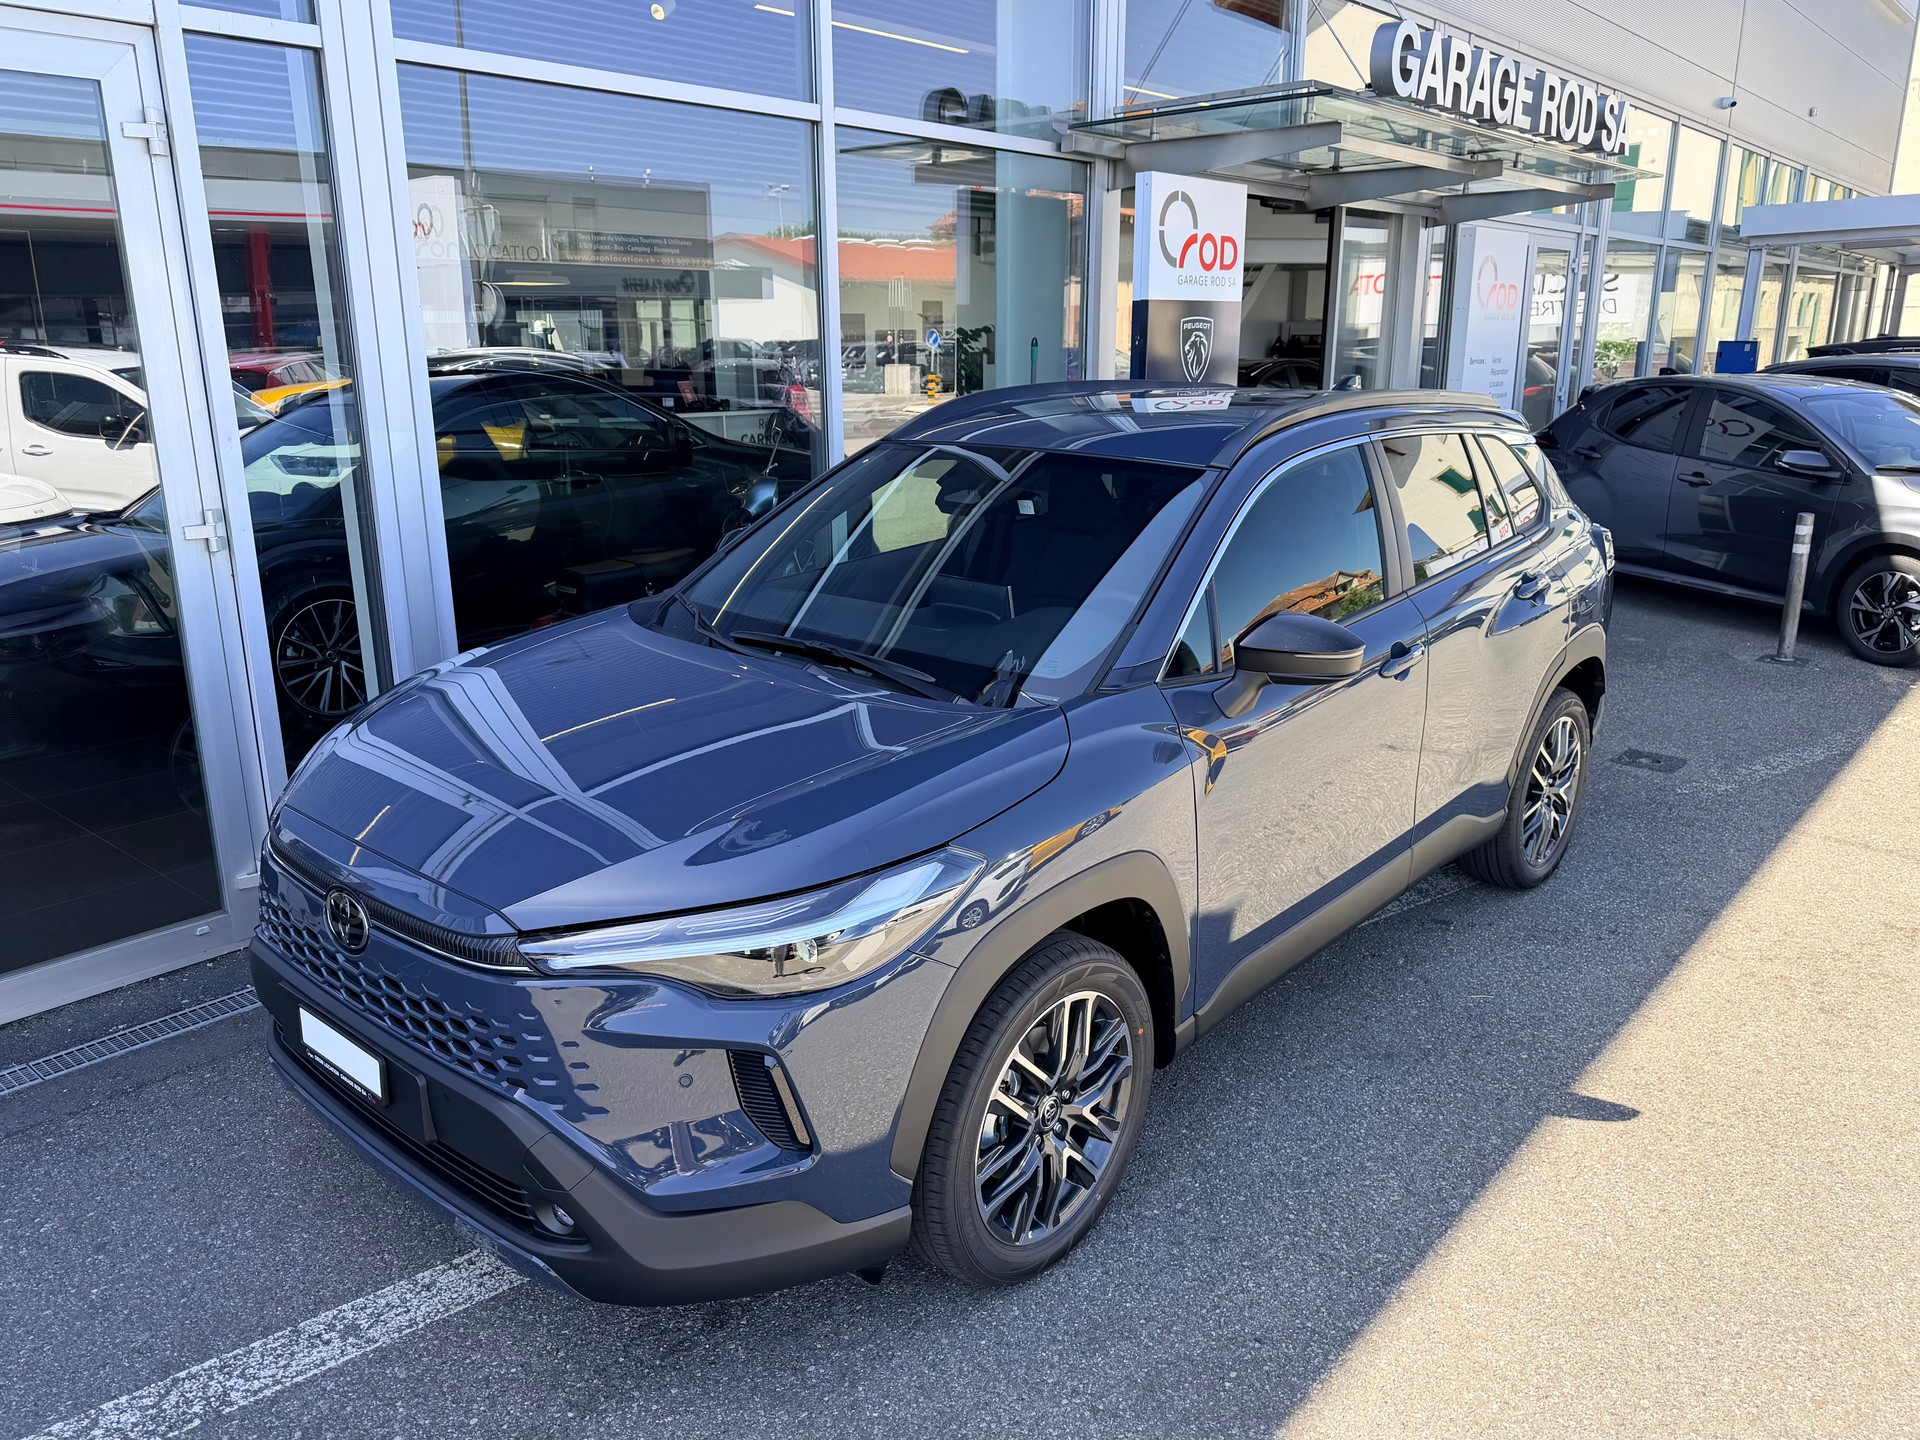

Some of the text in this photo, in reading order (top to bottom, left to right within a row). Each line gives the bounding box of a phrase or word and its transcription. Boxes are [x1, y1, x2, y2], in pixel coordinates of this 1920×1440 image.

[1391, 19, 1630, 156] GARAGE ROD SA
[591, 234, 606, 242] types
[639, 237, 662, 245] Tourisme
[593, 243, 610, 251] places
[627, 245, 650, 254] Camping
[1177, 275, 1237, 288] GARAGE ROD SA
[1183, 322, 1211, 330] PEUGEOT
